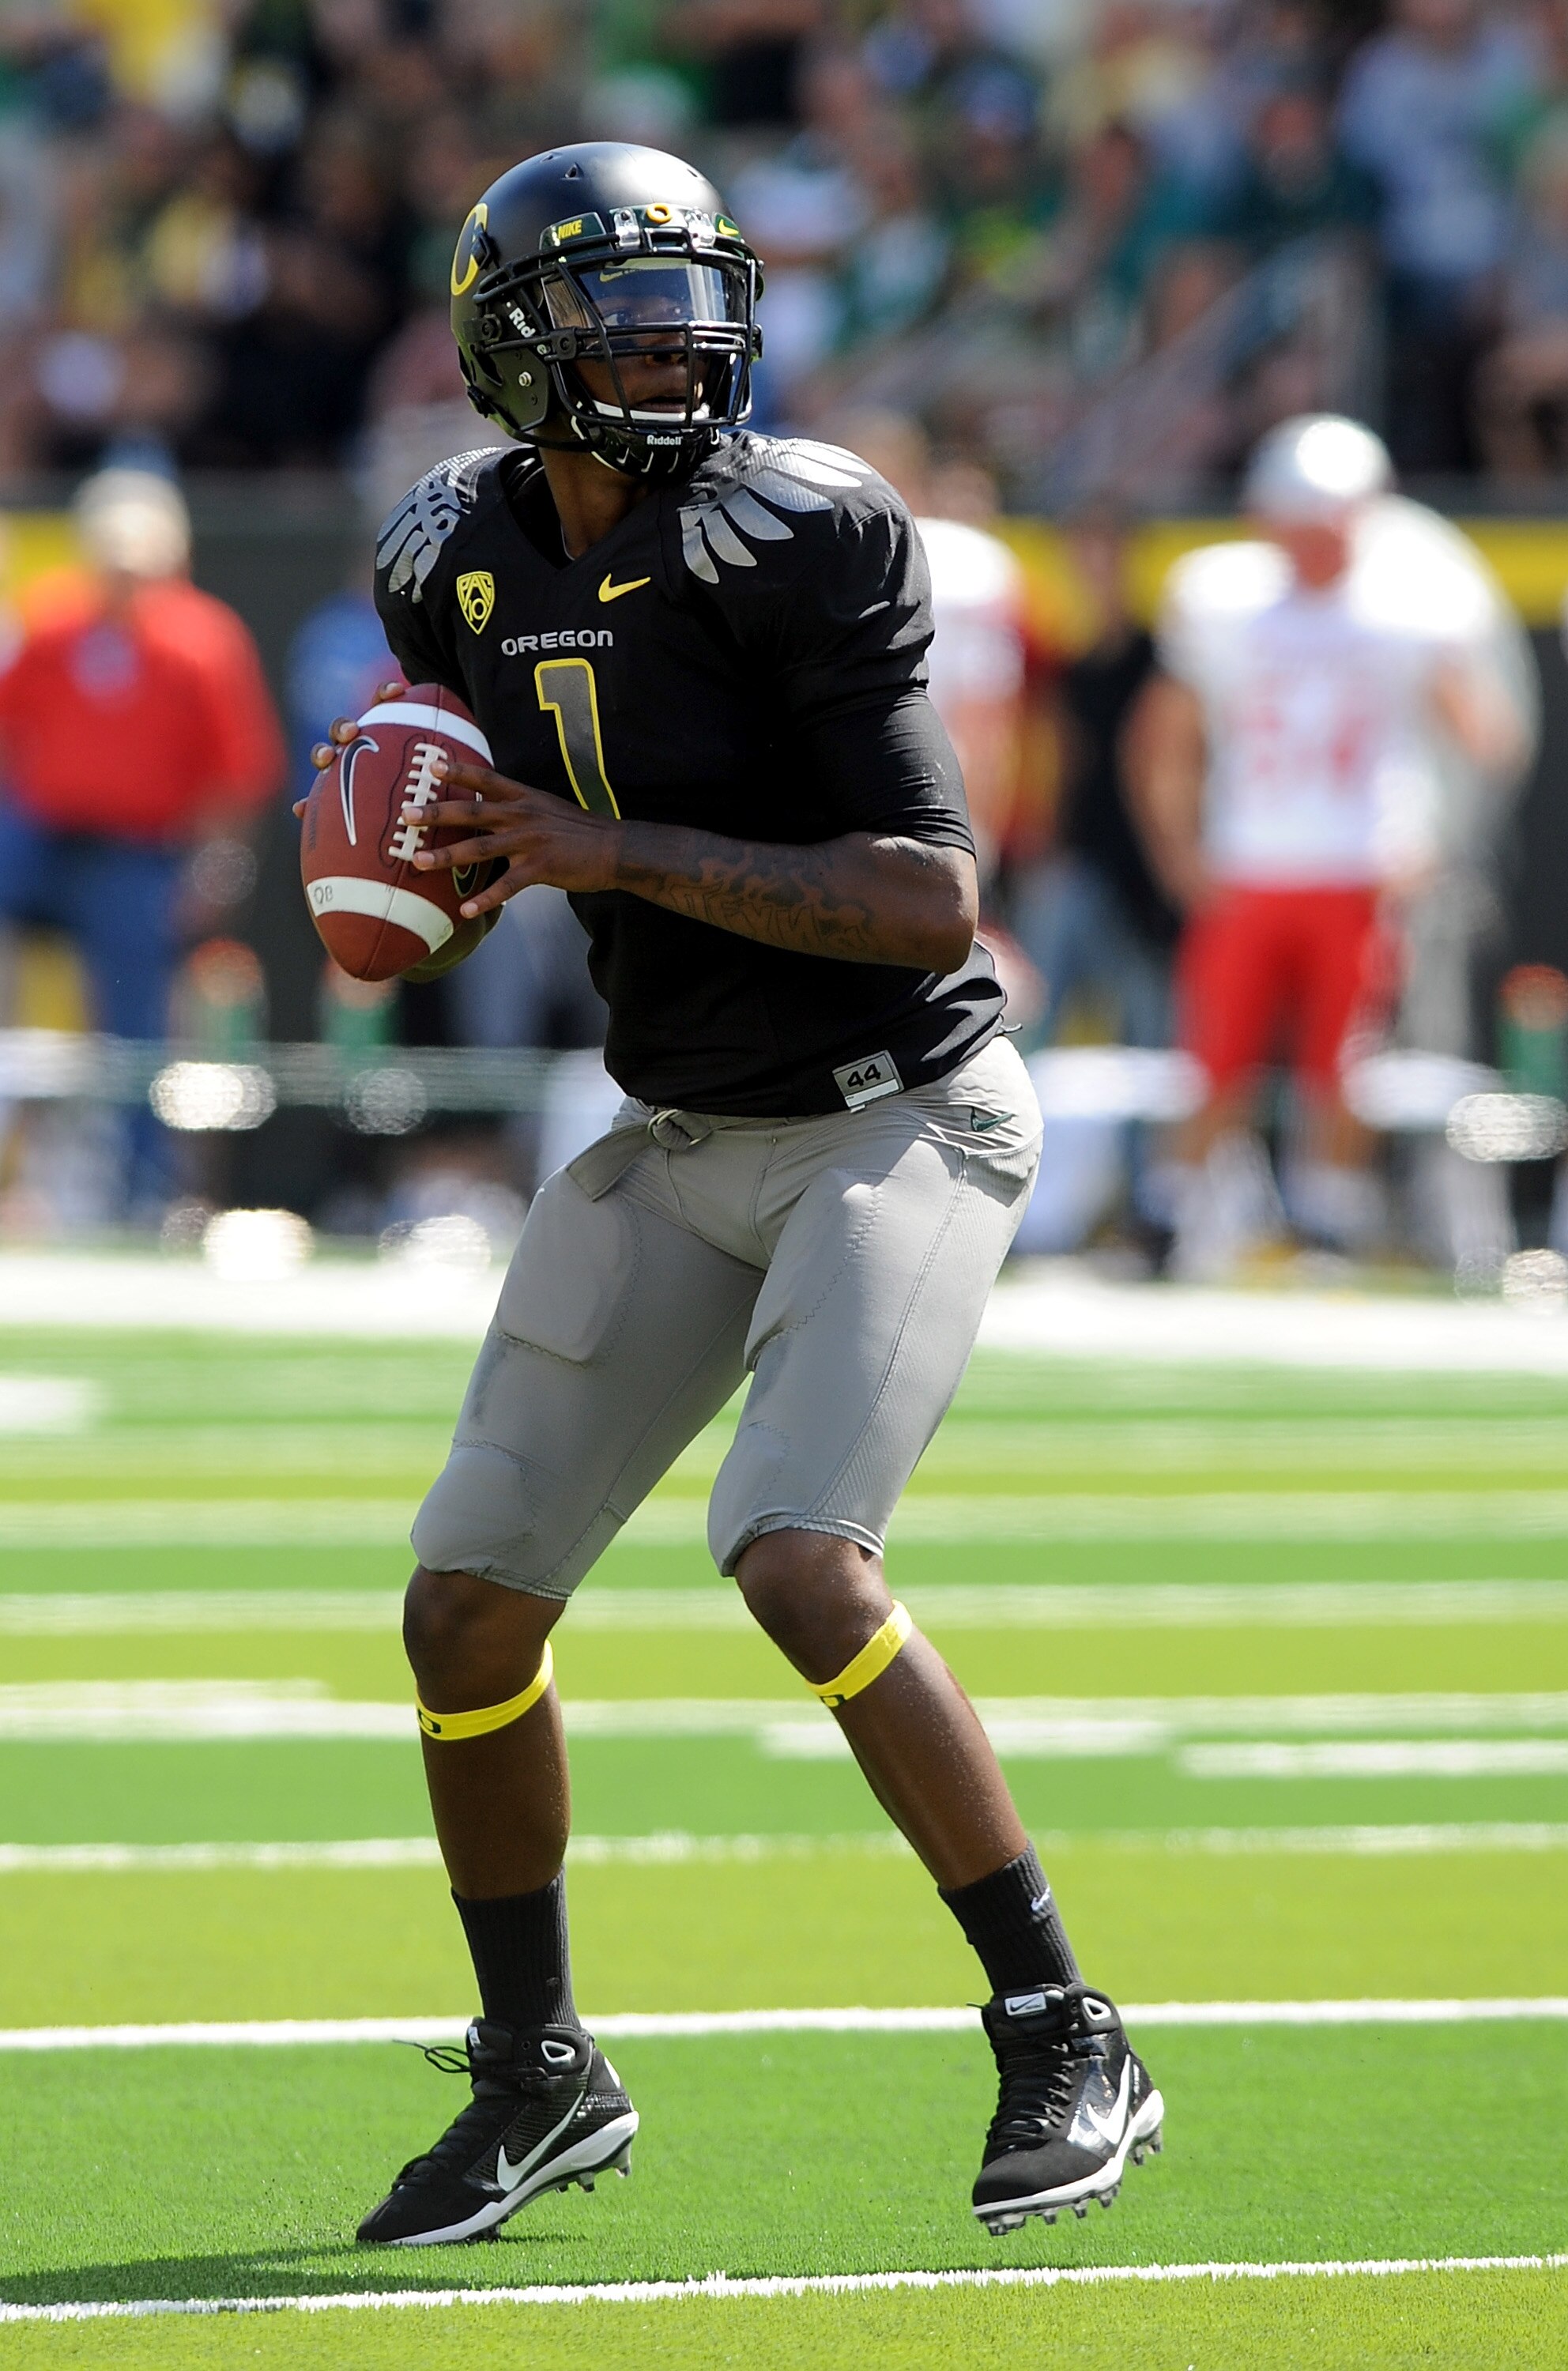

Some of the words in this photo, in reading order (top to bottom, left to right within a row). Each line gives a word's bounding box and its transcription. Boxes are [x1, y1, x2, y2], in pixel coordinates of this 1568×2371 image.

[557, 219, 583, 239] NIKE
[646, 435, 682, 445] Riddell
[458, 574, 492, 610] PAC
[468, 597, 488, 621] 10
[501, 629, 613, 656] OREGON
[534, 658, 621, 820] 1
[846, 1064, 881, 1087] 44
